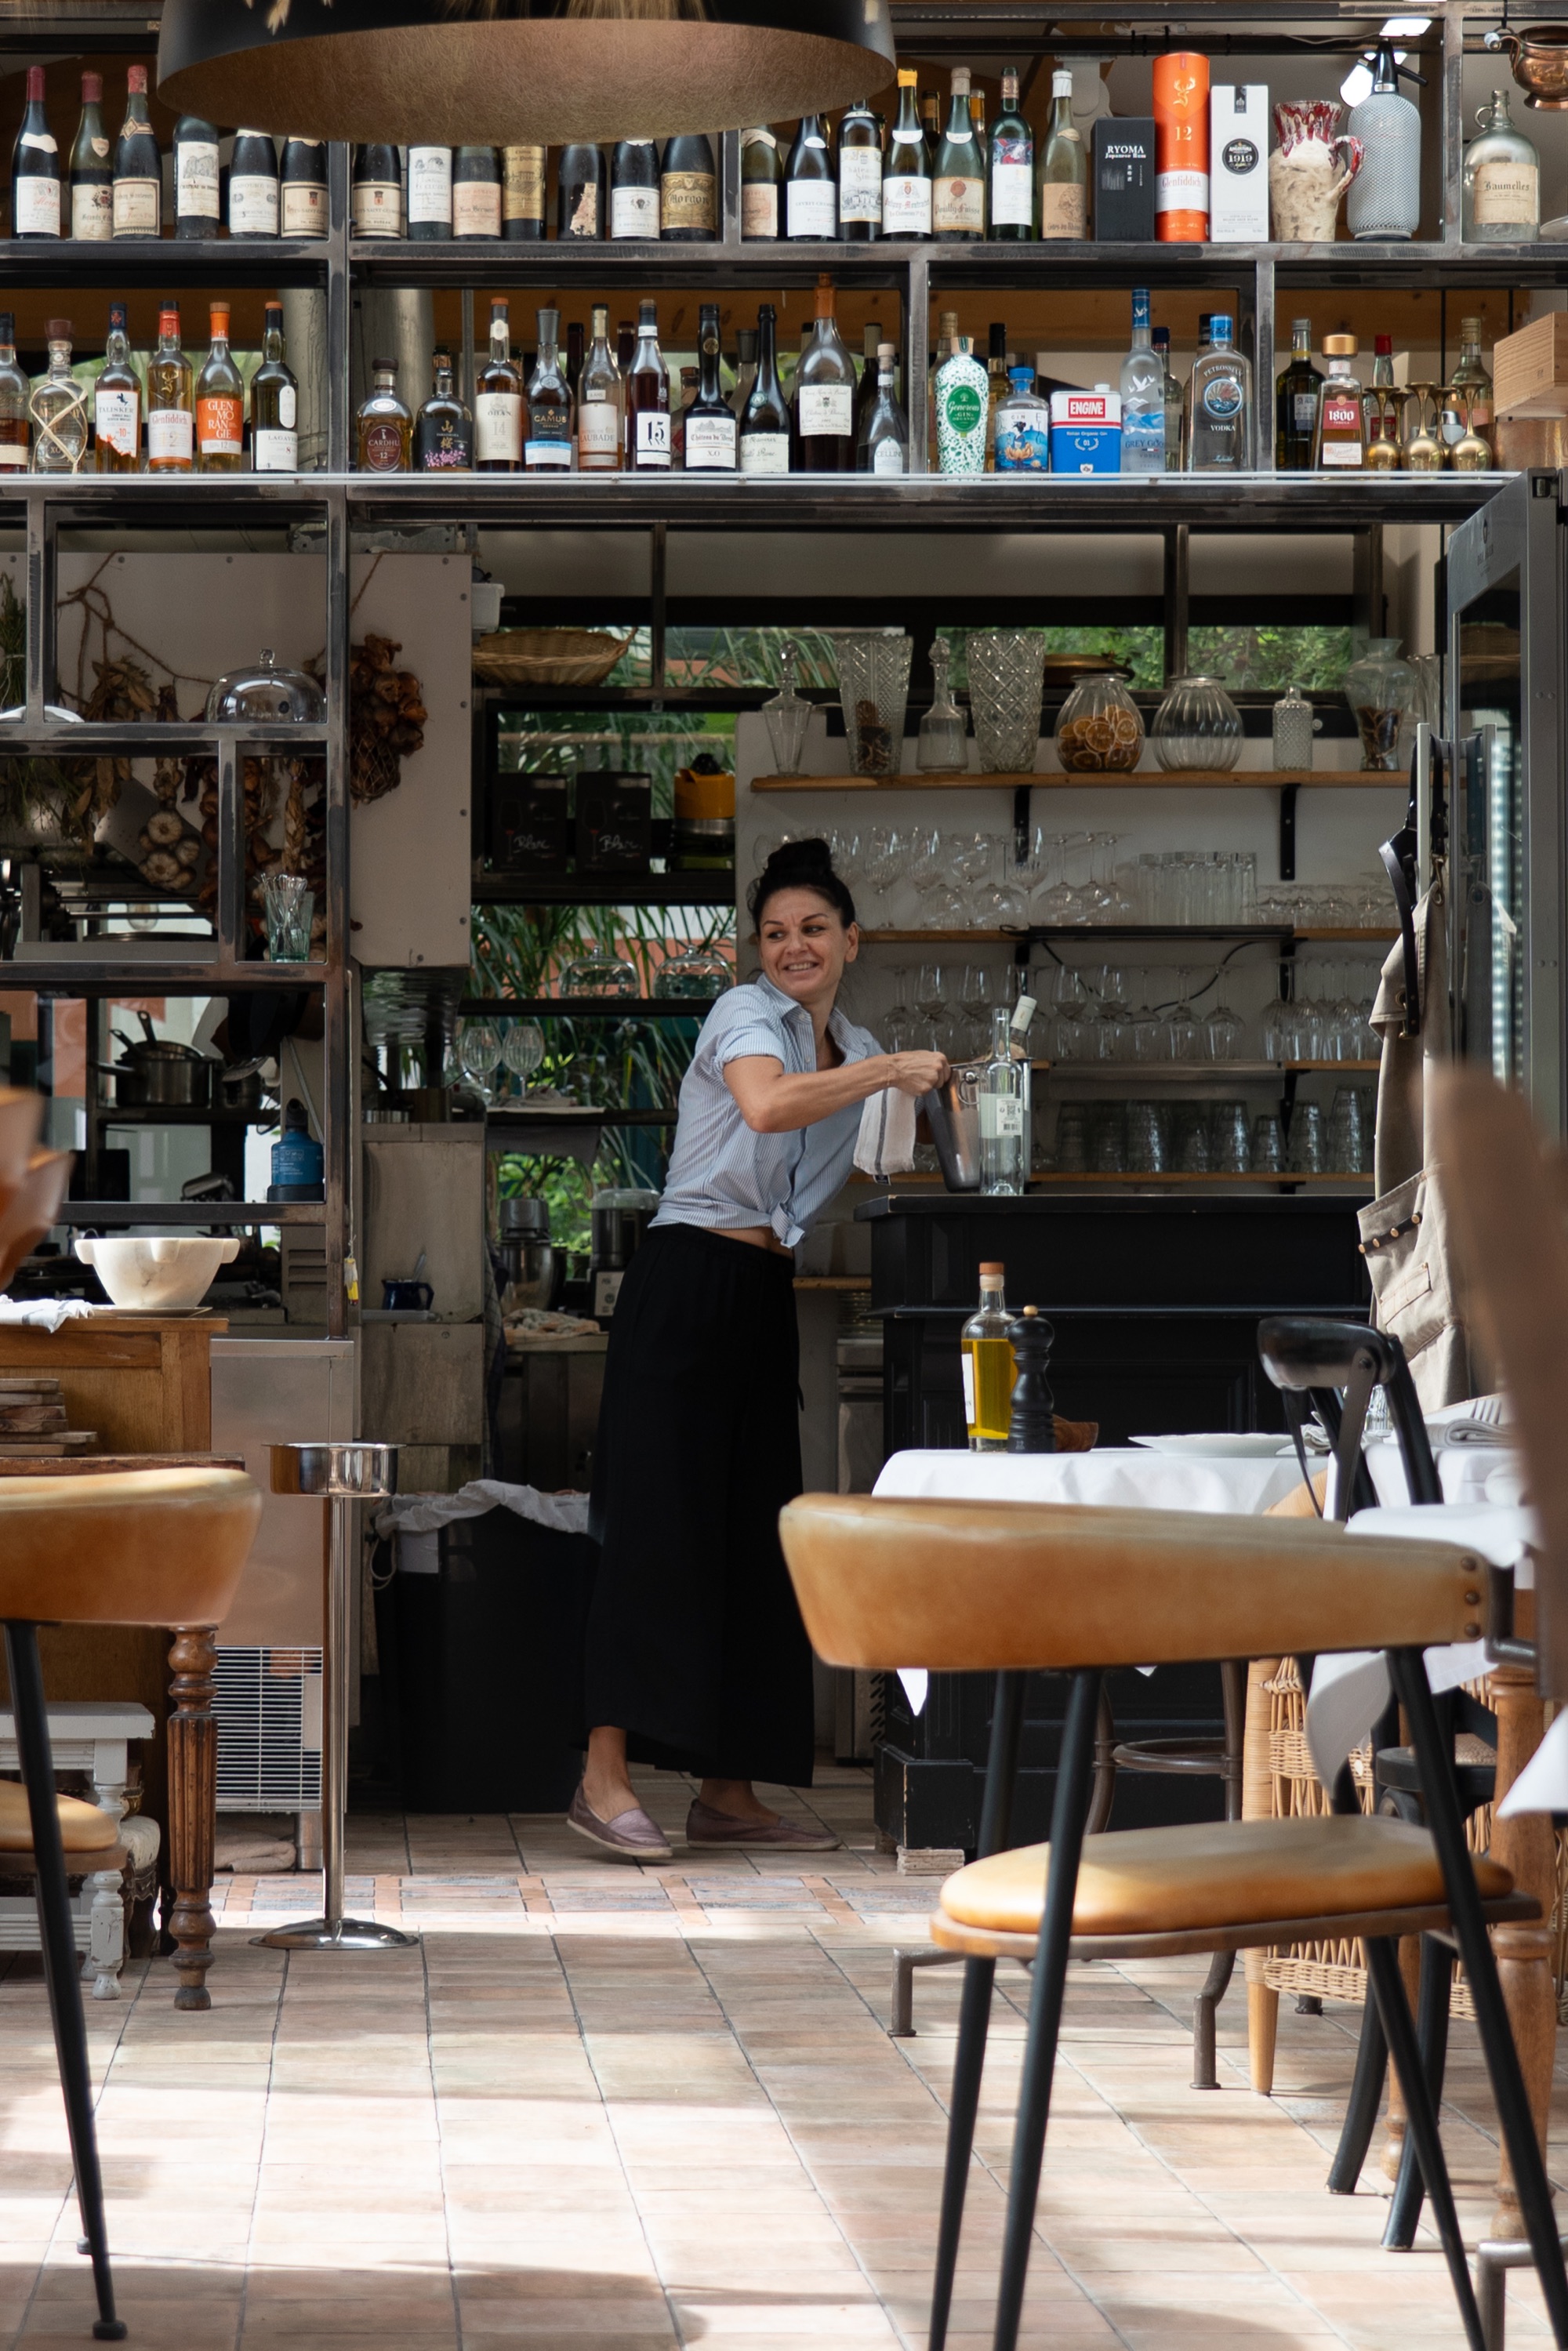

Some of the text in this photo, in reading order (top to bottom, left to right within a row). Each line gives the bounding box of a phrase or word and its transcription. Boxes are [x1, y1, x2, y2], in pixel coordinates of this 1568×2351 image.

[1175, 126, 1192, 141] 12
[1107, 145, 1145, 154] RYOMA
[1228, 154, 1253, 163] 1919
[1162, 177, 1202, 188] Glenfiddich
[670, 194, 709, 205] Morgon
[207, 401, 234, 411] GLEN
[1070, 401, 1104, 415] ENGINE
[152, 413, 187, 425] Glenfiddich
[216, 411, 234, 421] MO
[1329, 410, 1355, 422] 1800
[208, 420, 228, 430] RAN
[493, 422, 506, 437] 14
[119, 428, 127, 437] 10
[216, 430, 231, 439] GIE
[648, 421, 666, 446] 15
[1125, 440, 1145, 448] GREY
